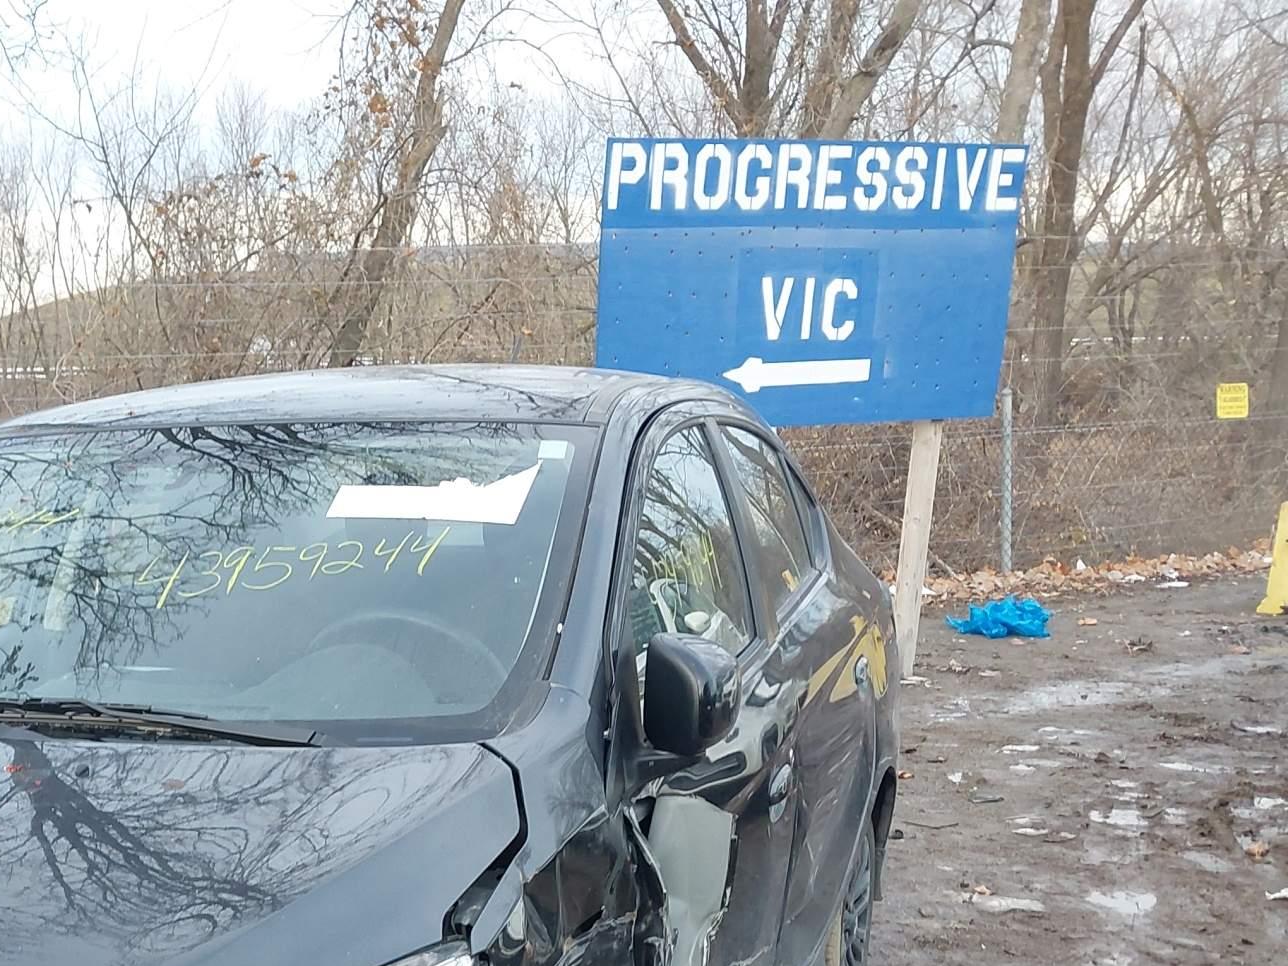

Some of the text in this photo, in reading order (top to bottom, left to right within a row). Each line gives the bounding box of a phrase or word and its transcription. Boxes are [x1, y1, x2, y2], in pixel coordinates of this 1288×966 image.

[607, 141, 1027, 212] PROGRESSIVE
[761, 276, 859, 341] VIC
[134, 525, 452, 609] 43959244
